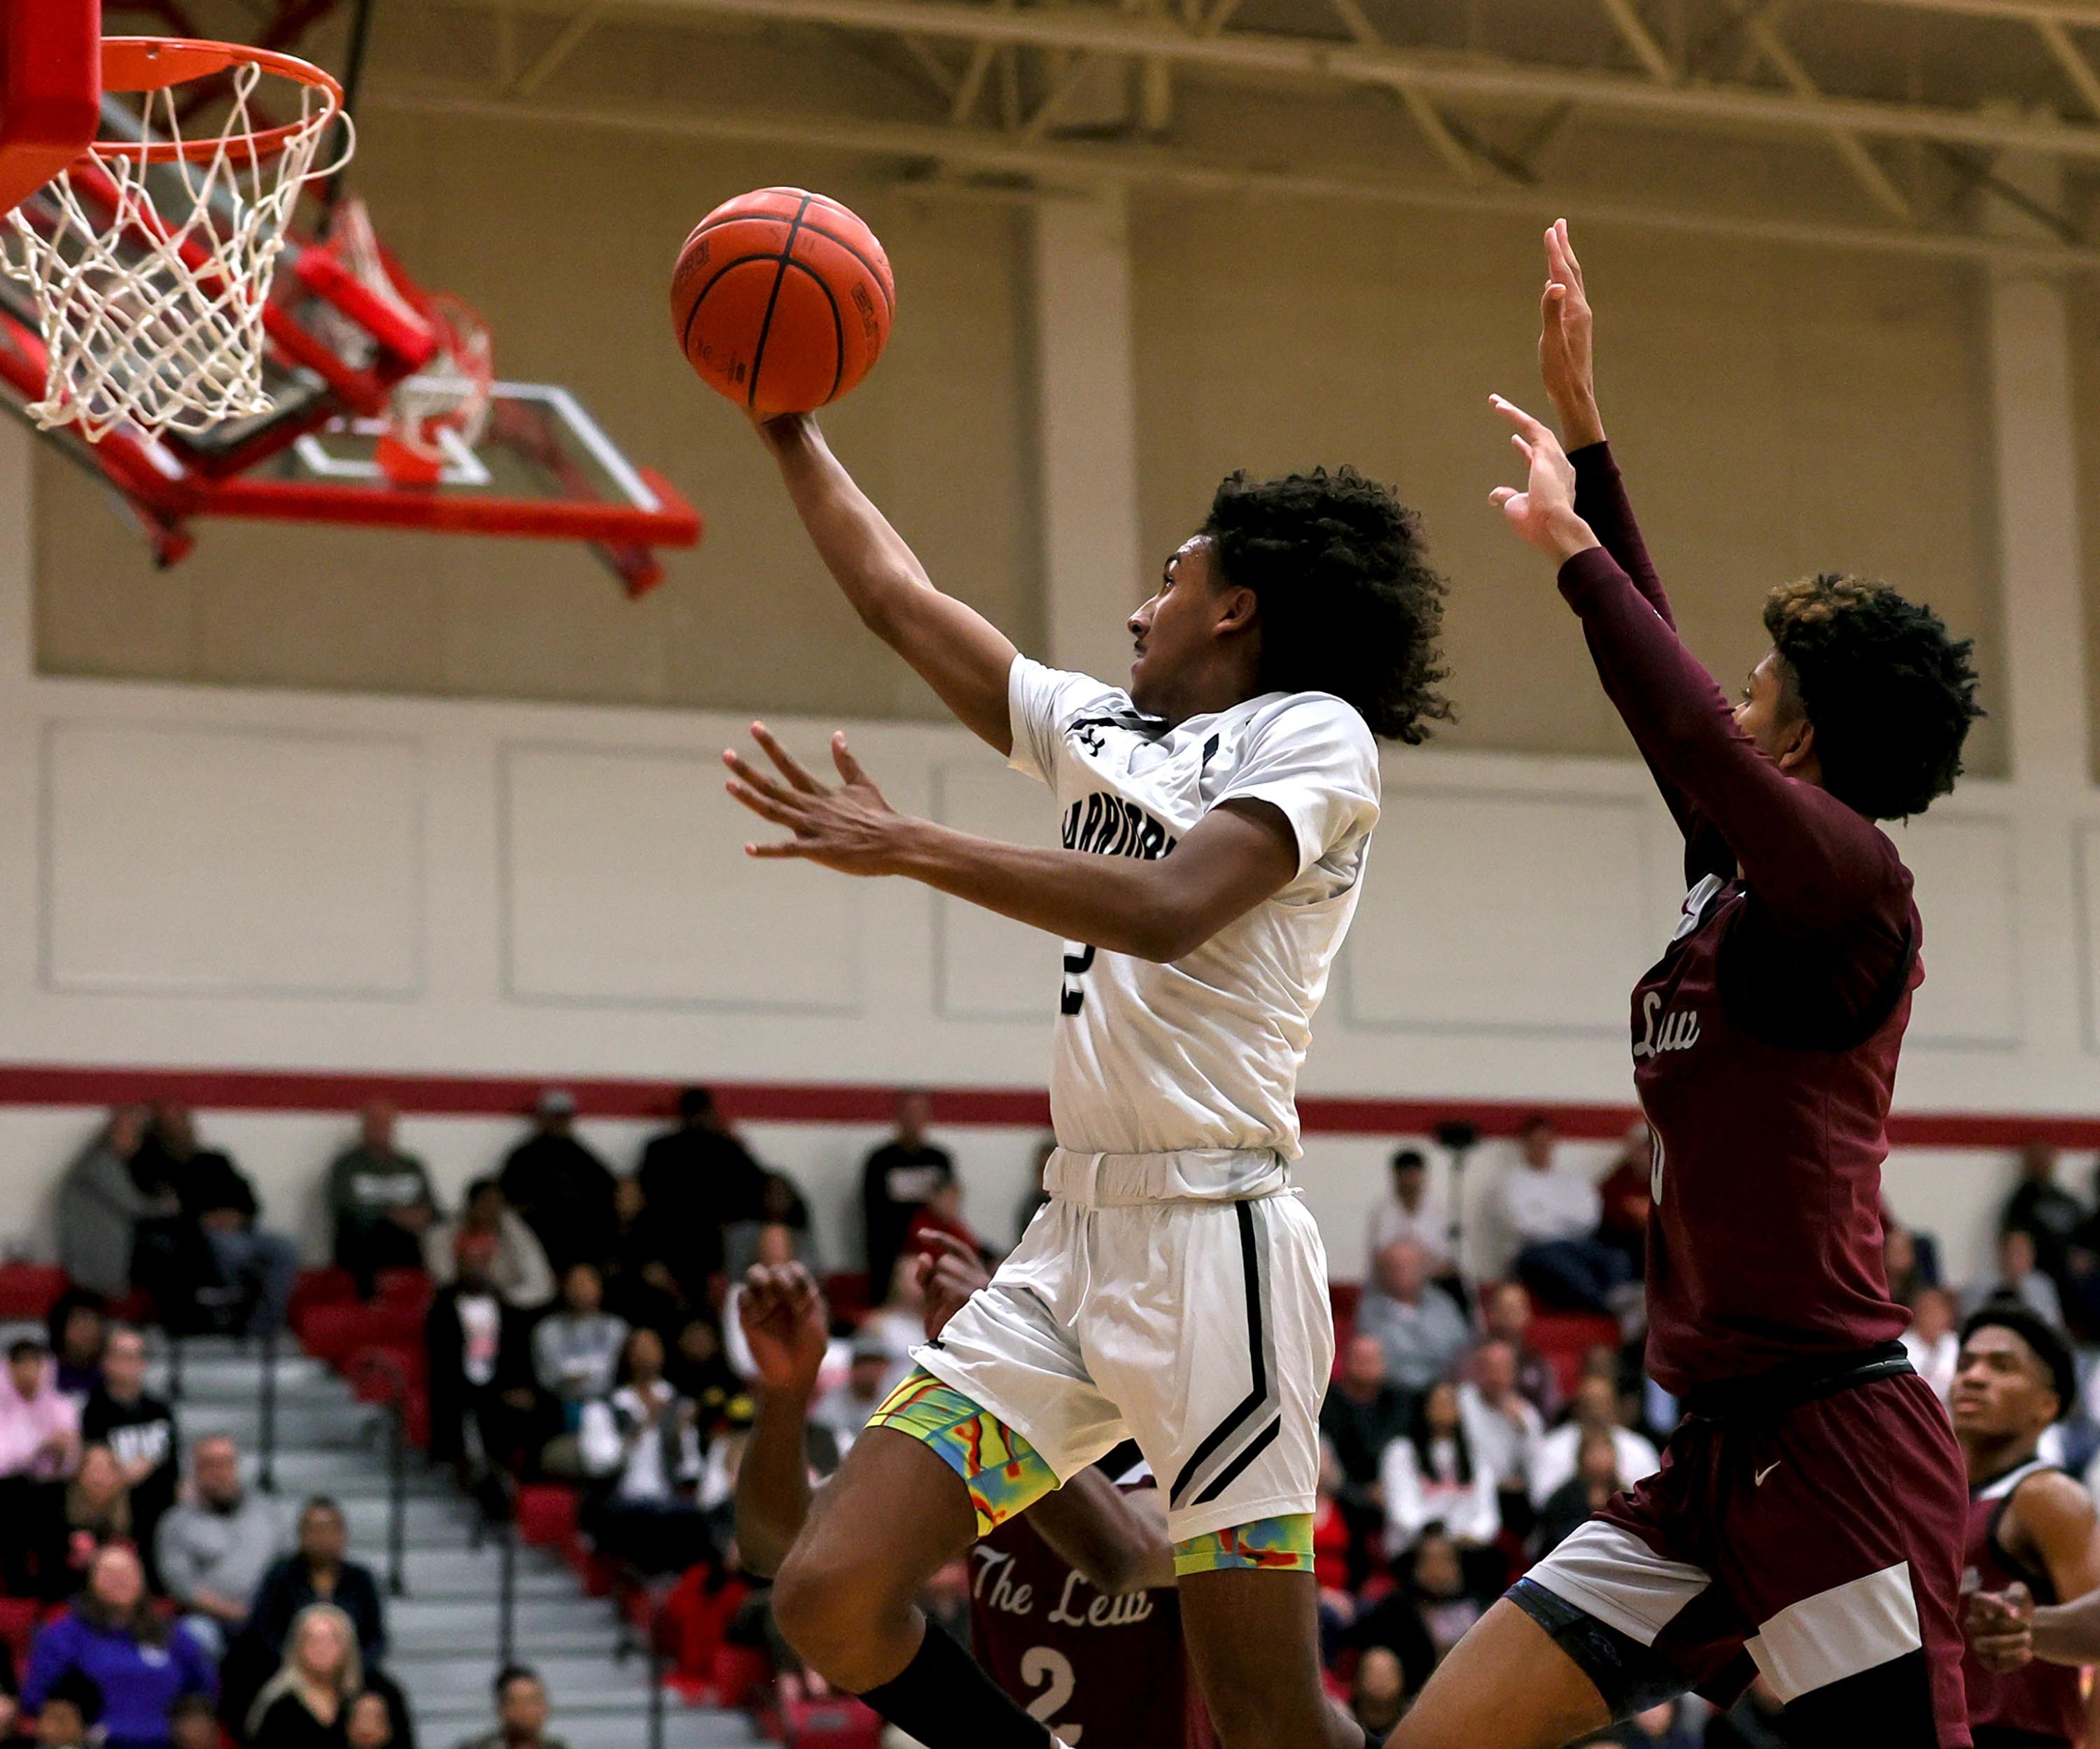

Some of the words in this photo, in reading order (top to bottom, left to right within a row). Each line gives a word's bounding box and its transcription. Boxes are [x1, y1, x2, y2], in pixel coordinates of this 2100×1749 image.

[971, 1544, 1034, 1615] The
[1047, 1568, 1154, 1628] Lew
[1020, 1645, 1084, 1747] 2
